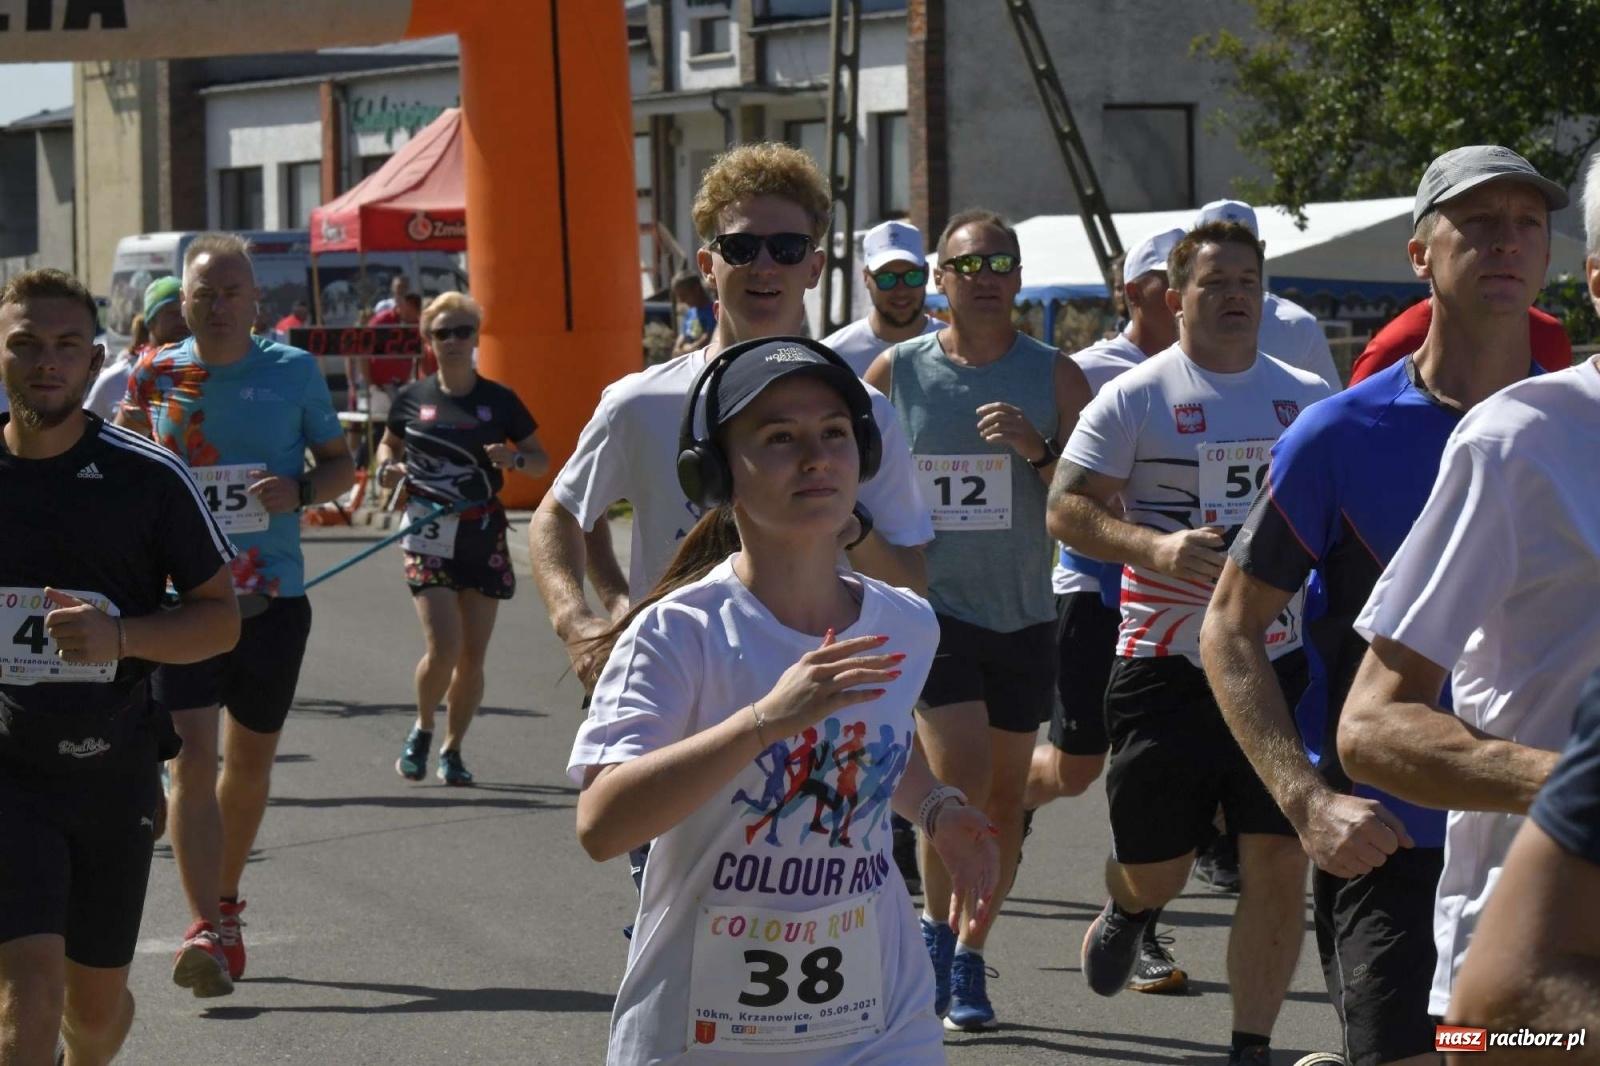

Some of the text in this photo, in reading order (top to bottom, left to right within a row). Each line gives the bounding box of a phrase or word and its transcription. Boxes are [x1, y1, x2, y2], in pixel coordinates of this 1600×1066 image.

[918, 460, 1004, 473] COLOUR RUN
[1206, 447, 1264, 461] COLOUR
[203, 484, 248, 513] 45
[933, 475, 987, 506] 12
[713, 849, 889, 896] COLOUR RUN
[711, 906, 865, 945] COLOUR RUN
[738, 946, 844, 1008] 38
[696, 998, 877, 1022] 10km, Krzanowice, 05.09.2021
